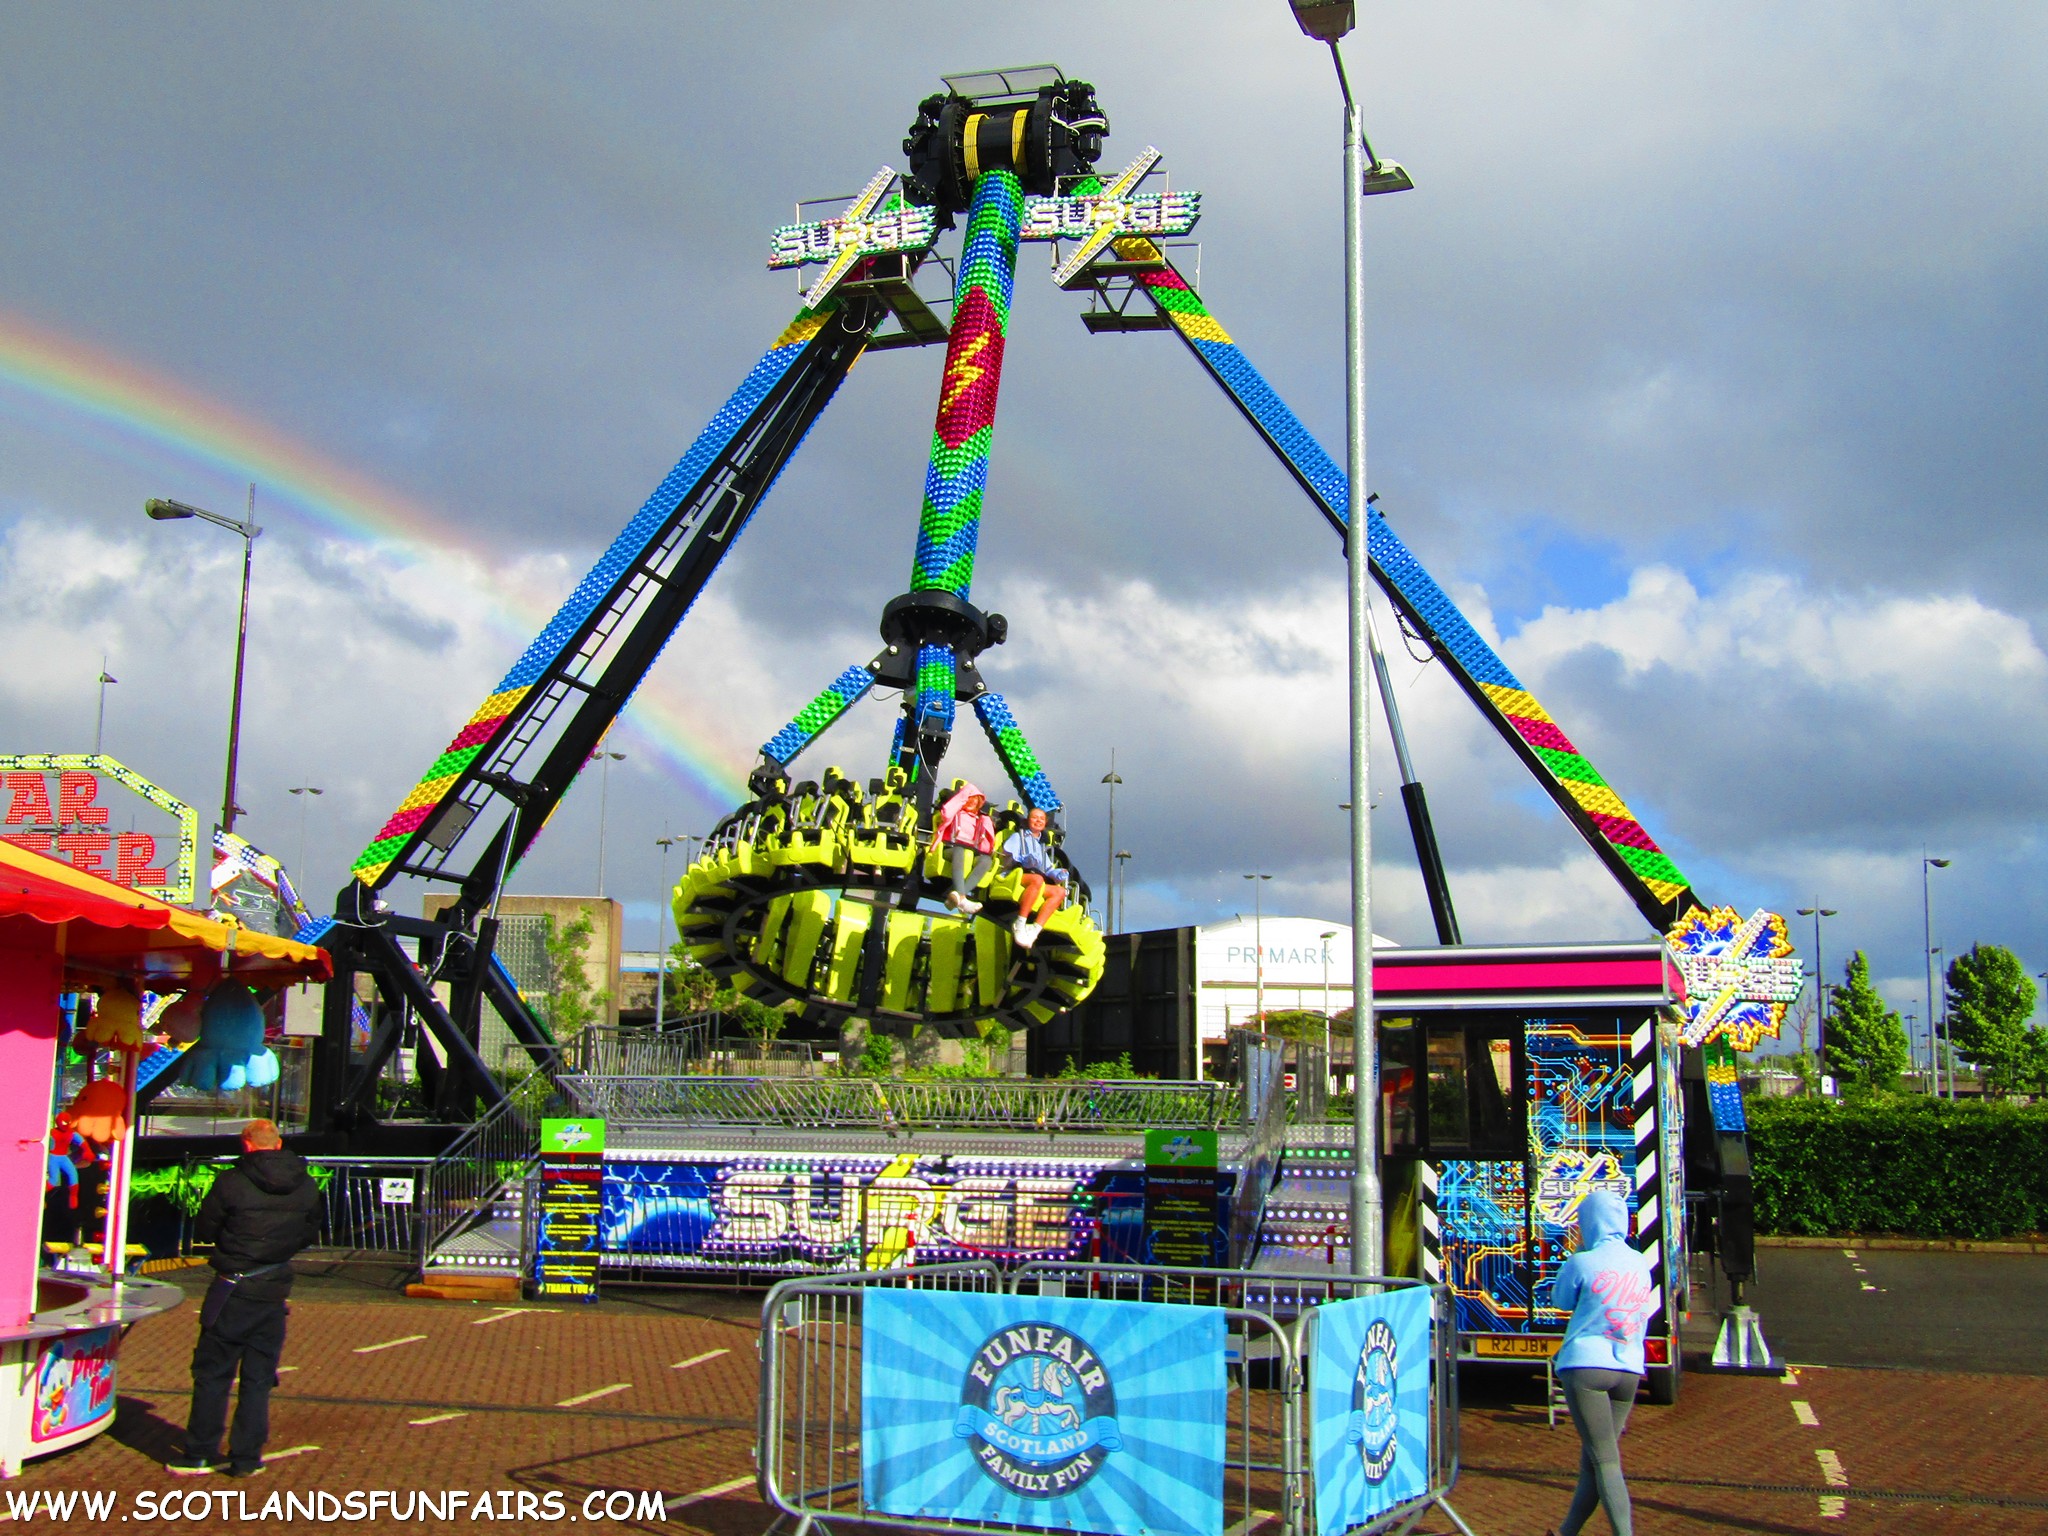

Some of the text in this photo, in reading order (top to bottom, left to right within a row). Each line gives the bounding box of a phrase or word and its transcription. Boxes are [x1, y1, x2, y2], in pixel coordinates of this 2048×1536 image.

[776, 212, 929, 260] SURGE
[1030, 197, 1192, 234] SURGE
[722, 1173, 1078, 1248] SURGE
[546, 1283, 588, 1293] THANK YOU
[971, 1327, 1105, 1395] FUNFAIR
[984, 1422, 1088, 1455] SCOTLAND
[980, 1444, 1093, 1491] FAMILY FUN
